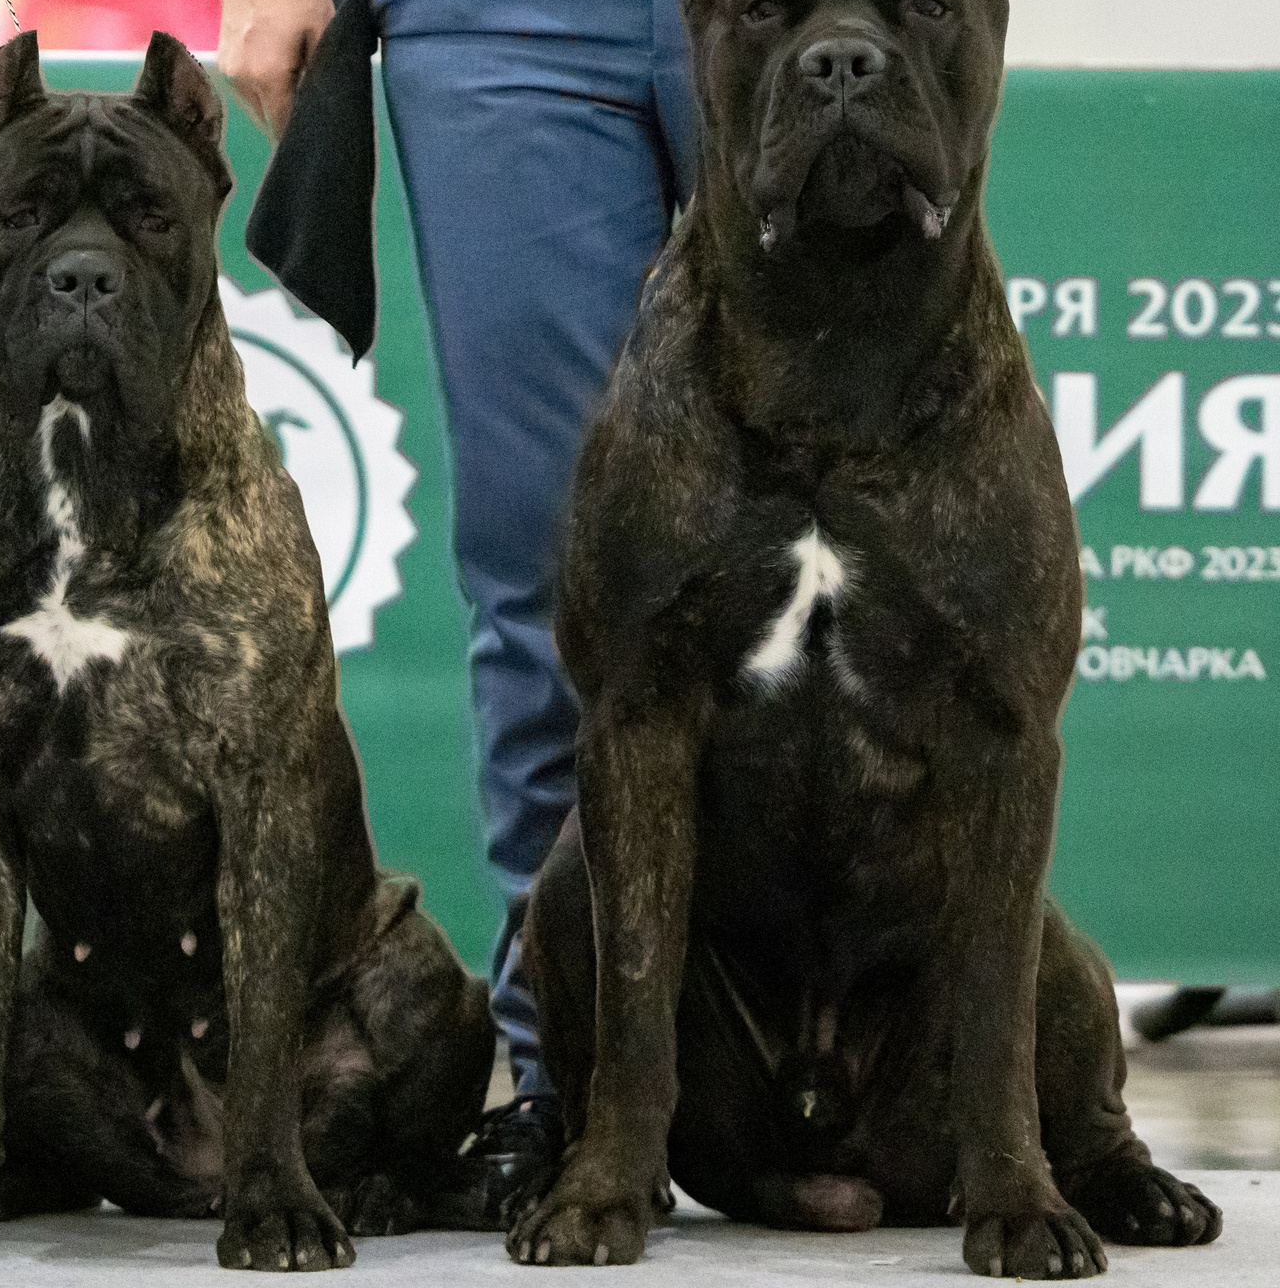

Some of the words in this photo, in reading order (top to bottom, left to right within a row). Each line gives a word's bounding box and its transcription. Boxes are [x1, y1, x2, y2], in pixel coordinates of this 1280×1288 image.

[1051, 370, 1280, 511] ИЯ
[1111, 545, 1196, 580] РКФ
[1077, 645, 1267, 680] ОВЧАРКА
